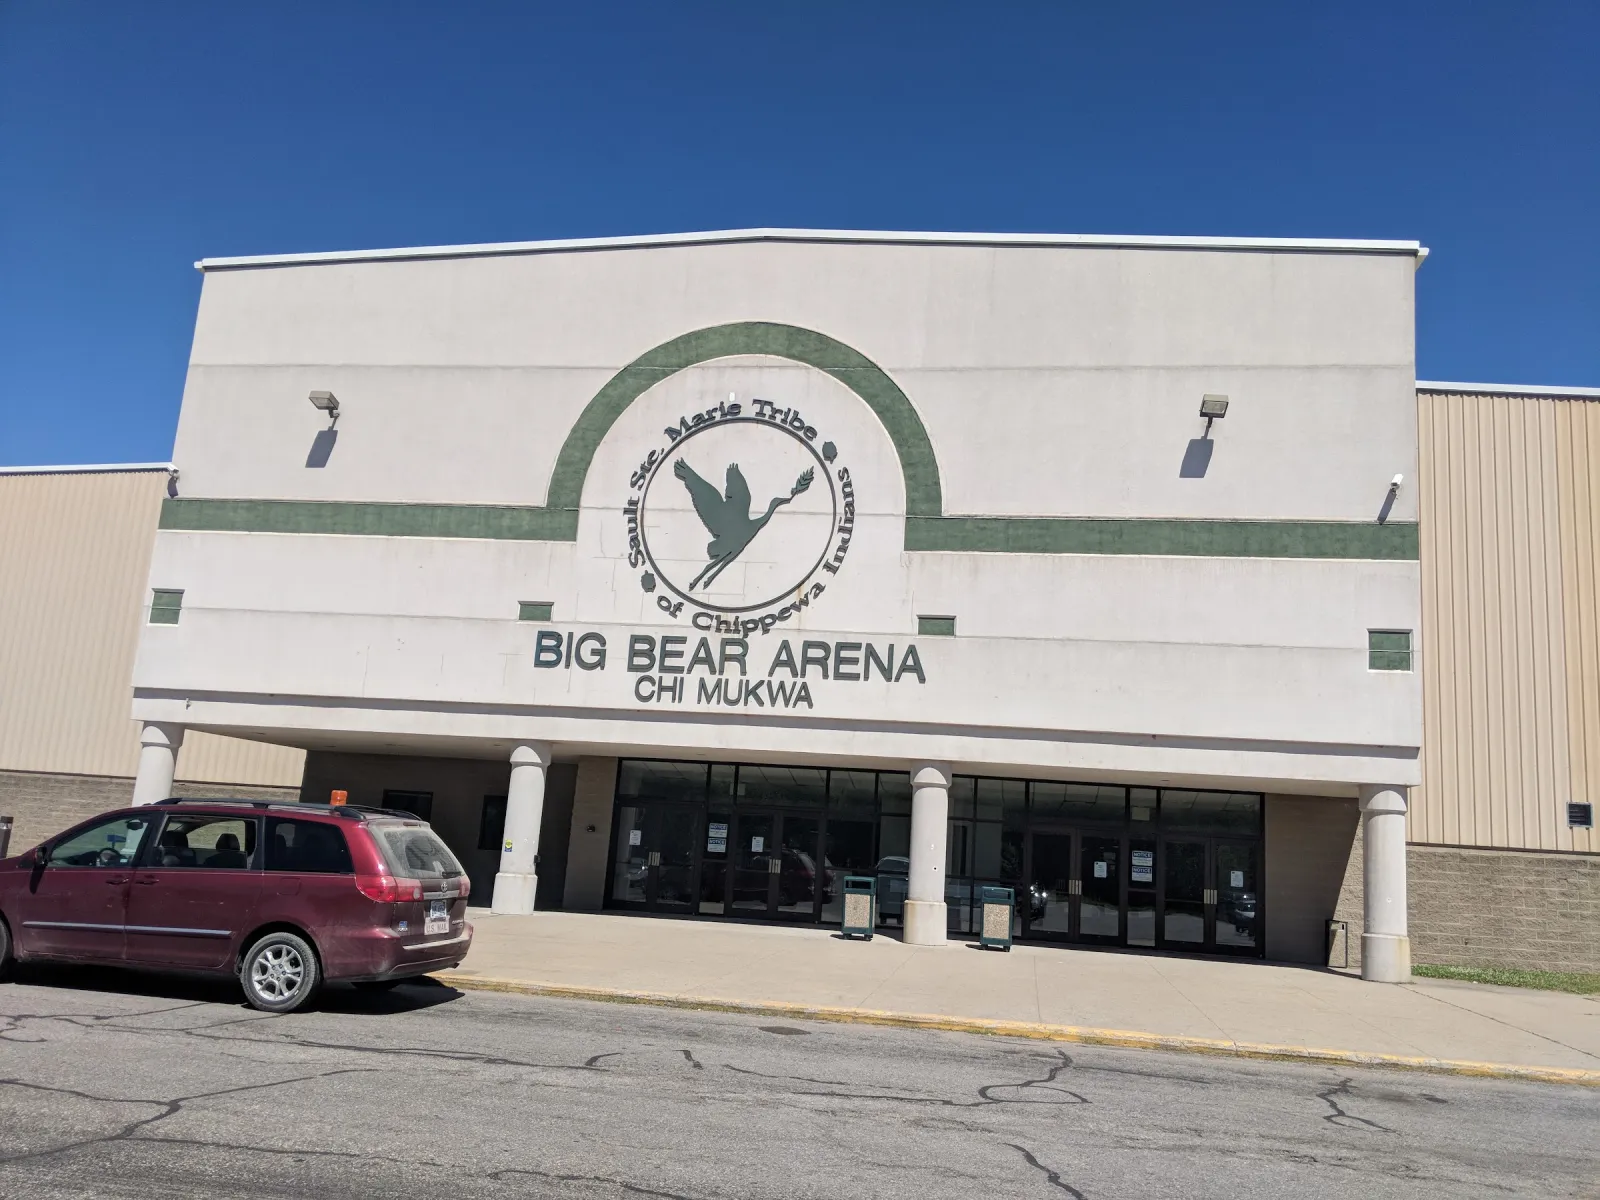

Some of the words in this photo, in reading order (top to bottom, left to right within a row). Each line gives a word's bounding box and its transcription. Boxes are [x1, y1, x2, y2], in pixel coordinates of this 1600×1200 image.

[622, 495, 646, 569] Sault
[664, 400, 742, 443] Marie
[752, 398, 818, 441] Tribe
[656, 594, 685, 619] of
[691, 581, 827, 638] Chippewa
[821, 466, 856, 577] Indians
[533, 629, 607, 671] BIG
[627, 634, 749, 676] BEAR
[768, 639, 927, 684] ARENA
[633, 674, 684, 704] CHI
[697, 678, 813, 709] MUKWA
